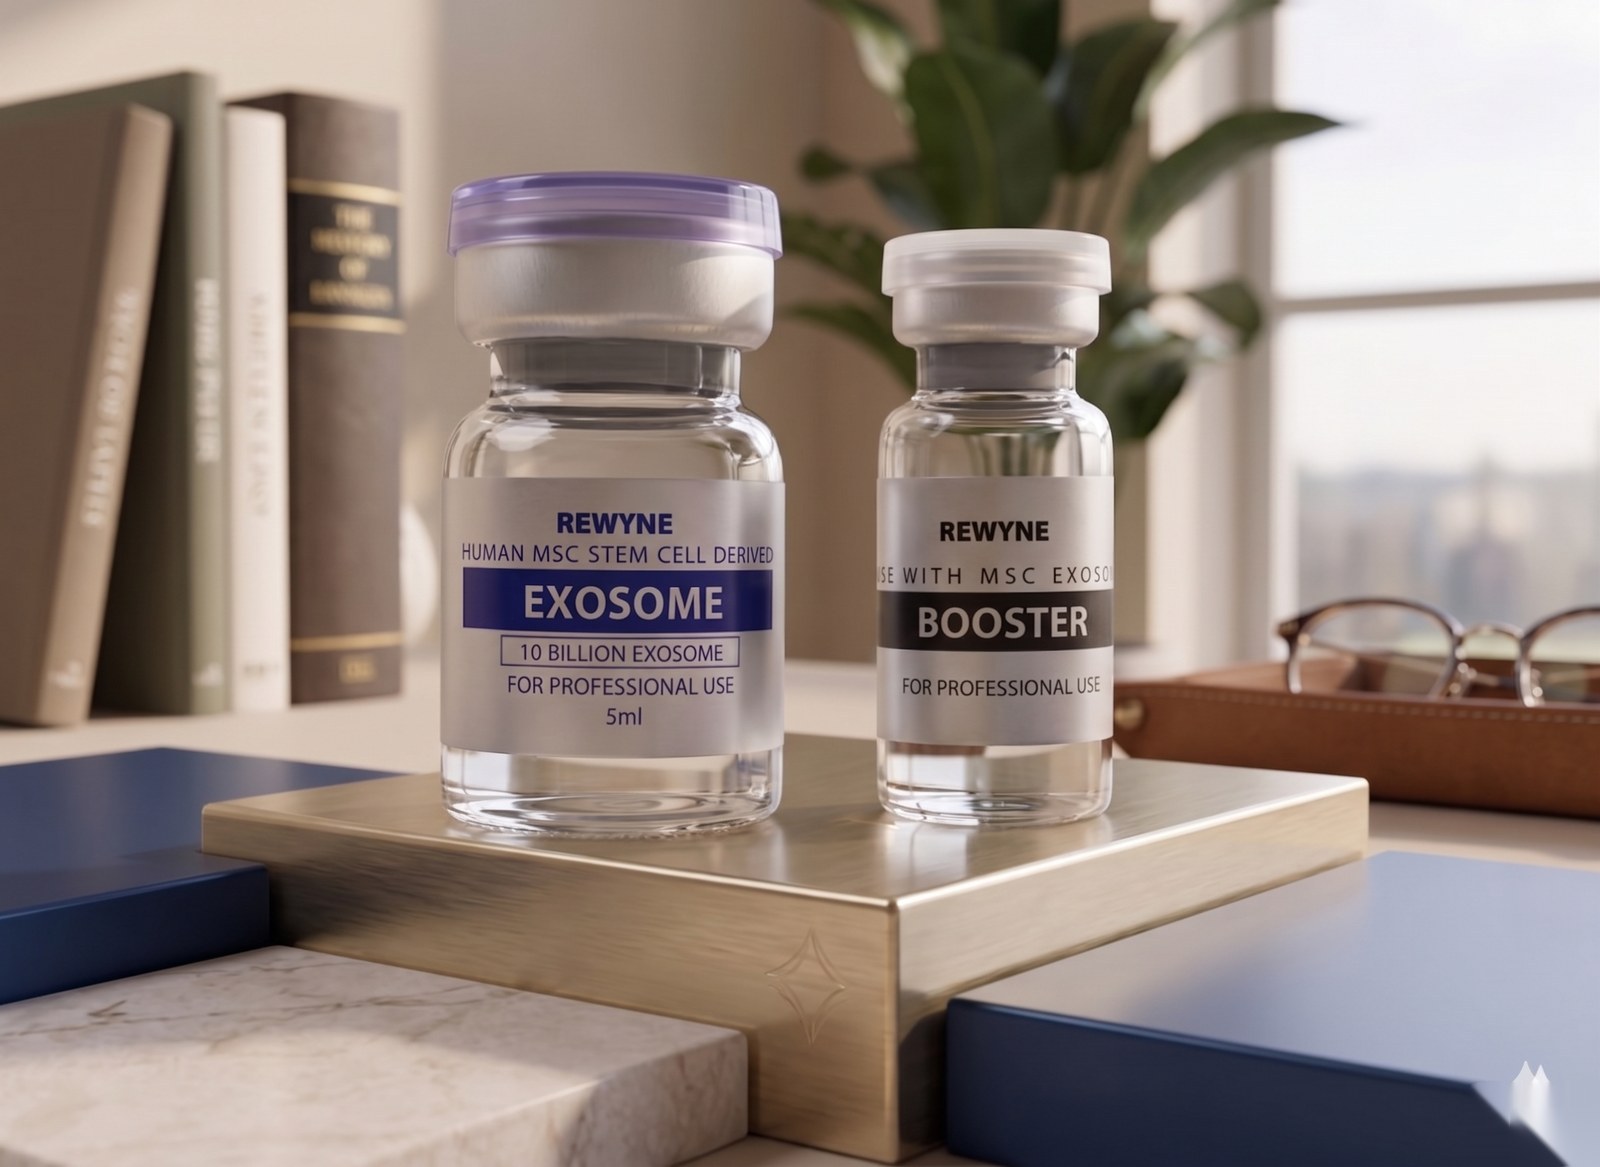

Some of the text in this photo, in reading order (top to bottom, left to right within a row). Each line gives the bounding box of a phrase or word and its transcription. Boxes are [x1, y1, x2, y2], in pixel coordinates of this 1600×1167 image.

[557, 512, 673, 535] REWYNE
[940, 521, 1049, 542] REWYNE
[462, 543, 774, 563] HUMAN MSC STEM CELL DERIVED
[903, 567, 962, 584] WITH
[980, 567, 1036, 584] MSC
[1053, 566, 1113, 584] EXOSO
[524, 584, 723, 620] EXOSOME
[918, 606, 1088, 639] BOOSTER
[520, 643, 724, 662] 10 BILLION EXOSOME
[508, 675, 734, 695] FOR PROFESSIONAL USE
[902, 676, 1101, 697] FOR PROFESSIONAL USE
[606, 706, 642, 725] 5ml
